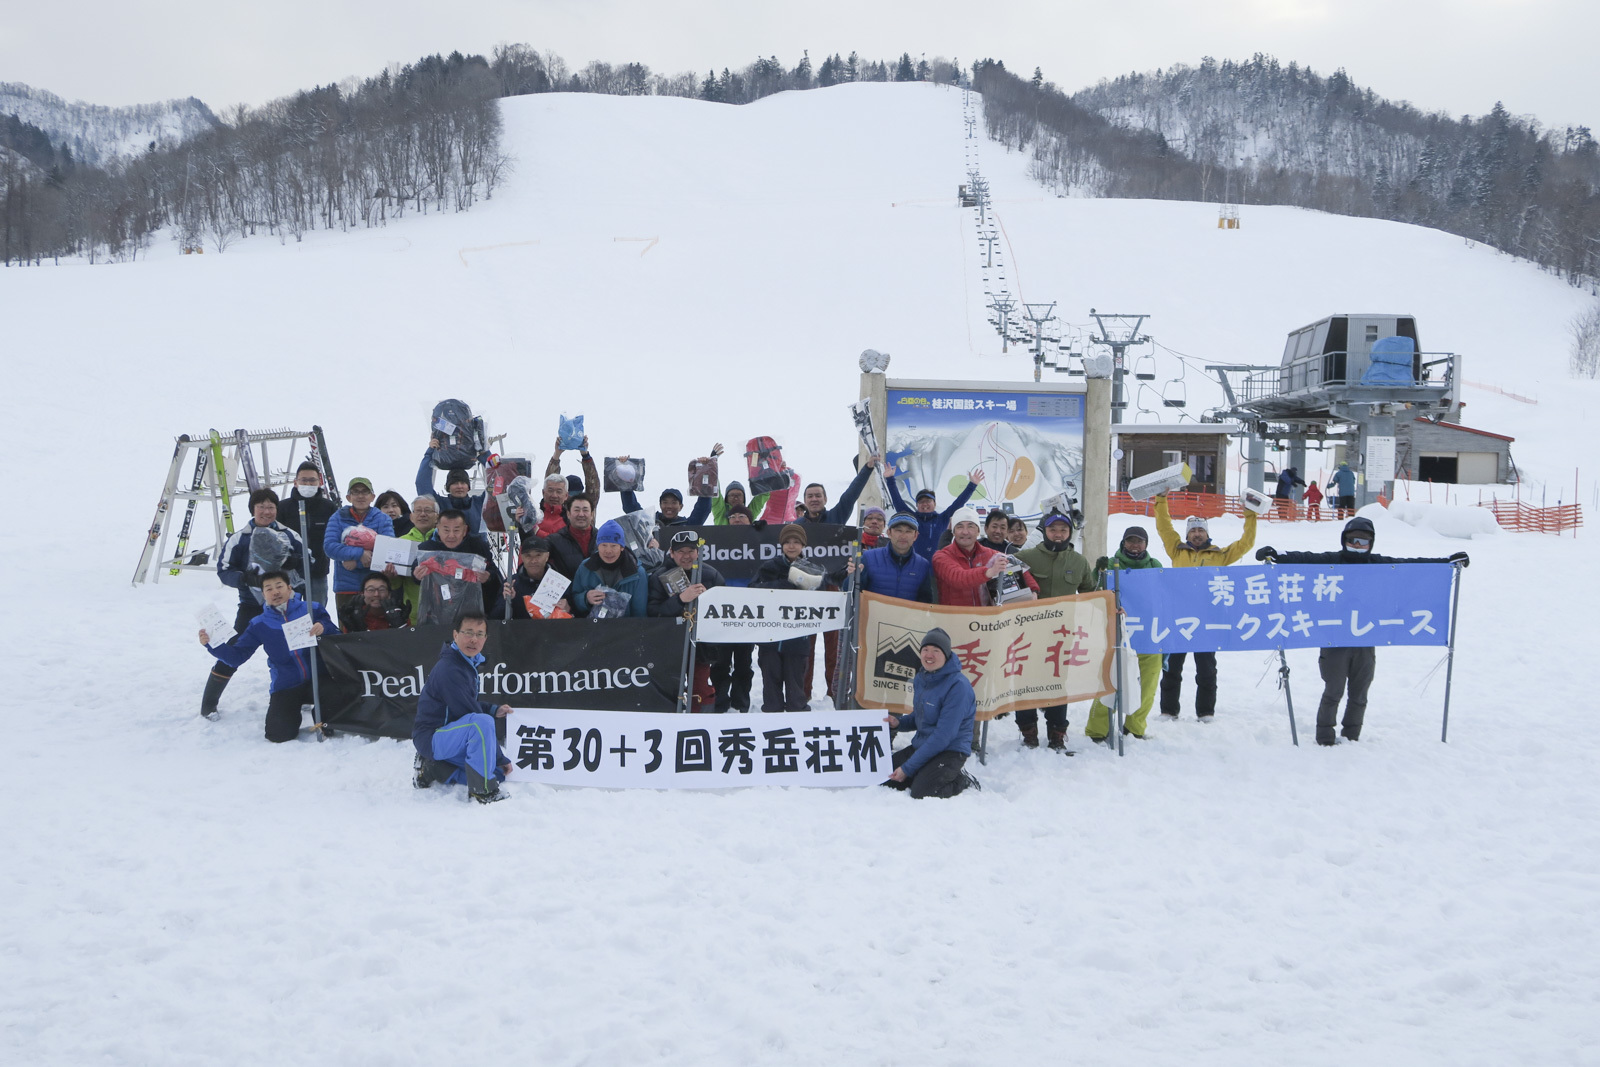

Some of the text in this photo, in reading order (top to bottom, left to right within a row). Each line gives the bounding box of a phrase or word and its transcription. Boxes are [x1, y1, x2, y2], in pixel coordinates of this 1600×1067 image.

[932, 398, 1017, 411] 桂沢国設スキー場
[193, 452, 208, 489] HEAD
[701, 541, 853, 561] Black Dimond
[1208, 573, 1344, 607] 秀岳荘杯
[704, 604, 841, 621] ARAI TENT
[969, 609, 1064, 633] Outdoor Specialists
[1125, 609, 1437, 644] テレマークスキーレース
[951, 624, 1090, 687] 秀岳荘
[478, 661, 651, 695] rformance
[872, 680, 900, 691] SINCE
[976, 683, 1063, 708] p://www.shugakuso.com
[516, 724, 885, 775] 第30+3回秀岳荘杯
